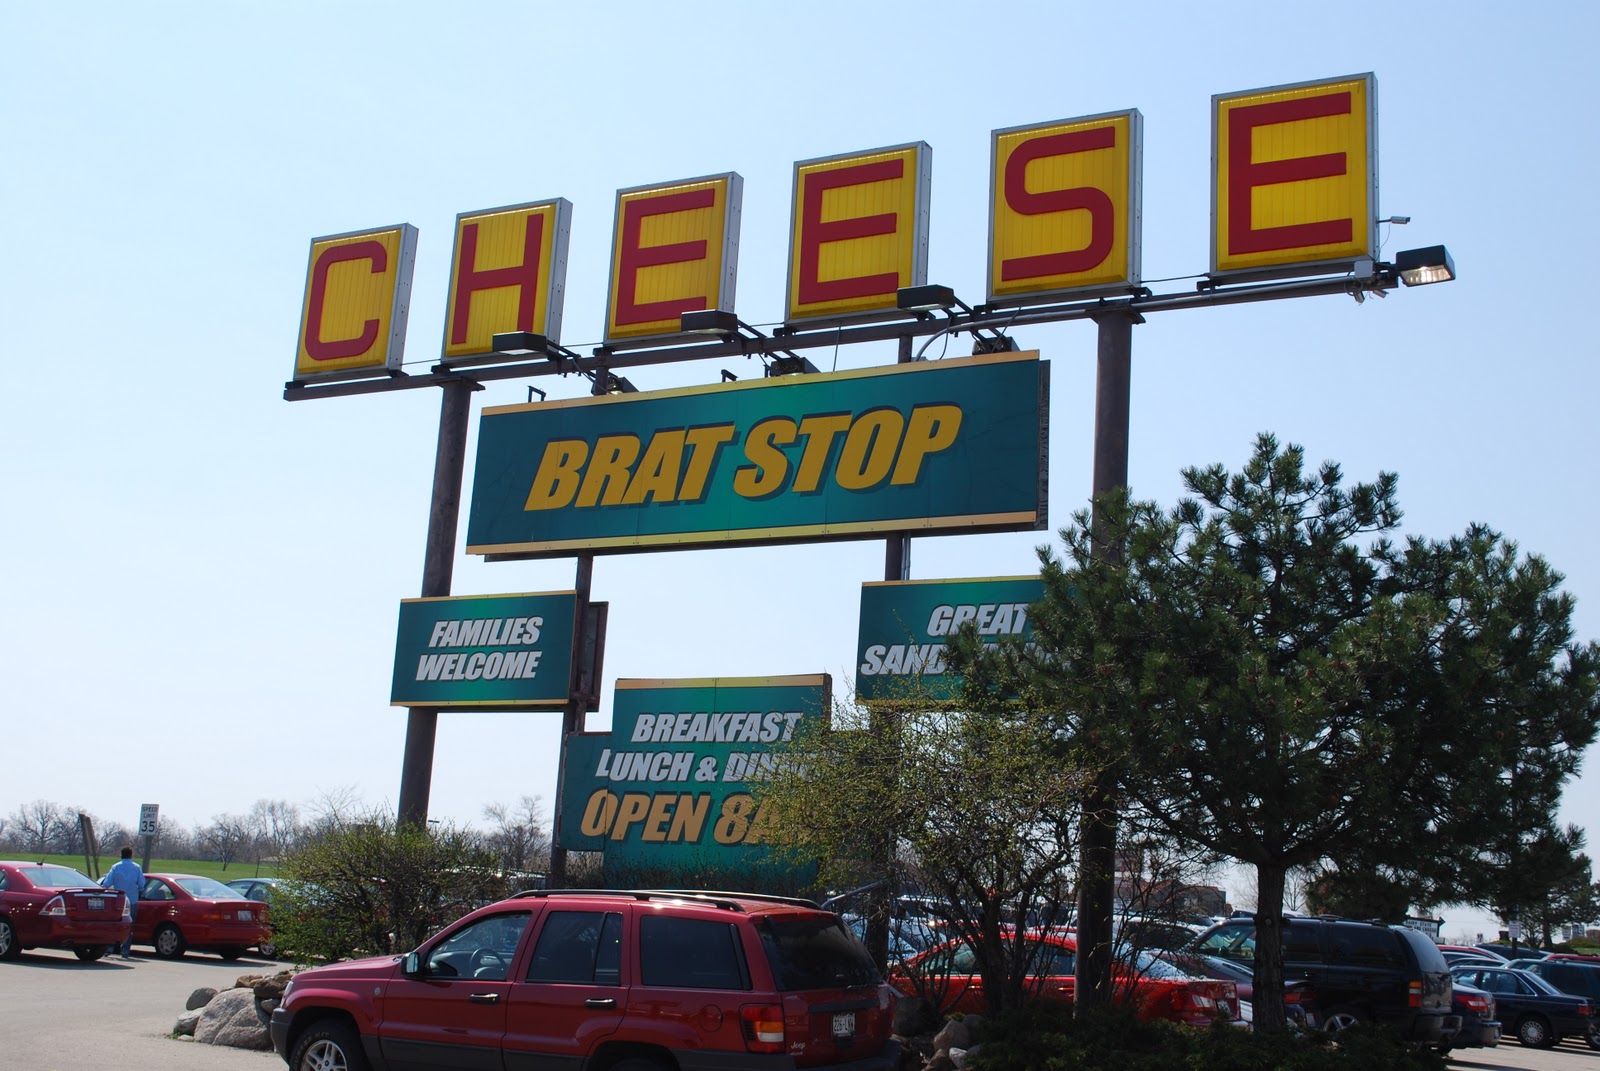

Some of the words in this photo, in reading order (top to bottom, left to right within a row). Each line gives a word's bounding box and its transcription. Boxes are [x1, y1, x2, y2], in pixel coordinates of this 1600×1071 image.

[304, 91, 1353, 361] CHEESE
[523, 424, 736, 512] BRAT
[732, 403, 964, 499] STOP
[428, 616, 544, 648] FAMILIES
[926, 603, 1029, 636] GREAT
[415, 651, 543, 681] WELCOME
[631, 712, 803, 742] BREAKFAST
[595, 749, 695, 781] LUNCH
[695, 757, 719, 782] &
[141, 820, 156, 832] 35
[580, 789, 712, 842] OPEN
[790, 1042, 806, 1050] Jeep
